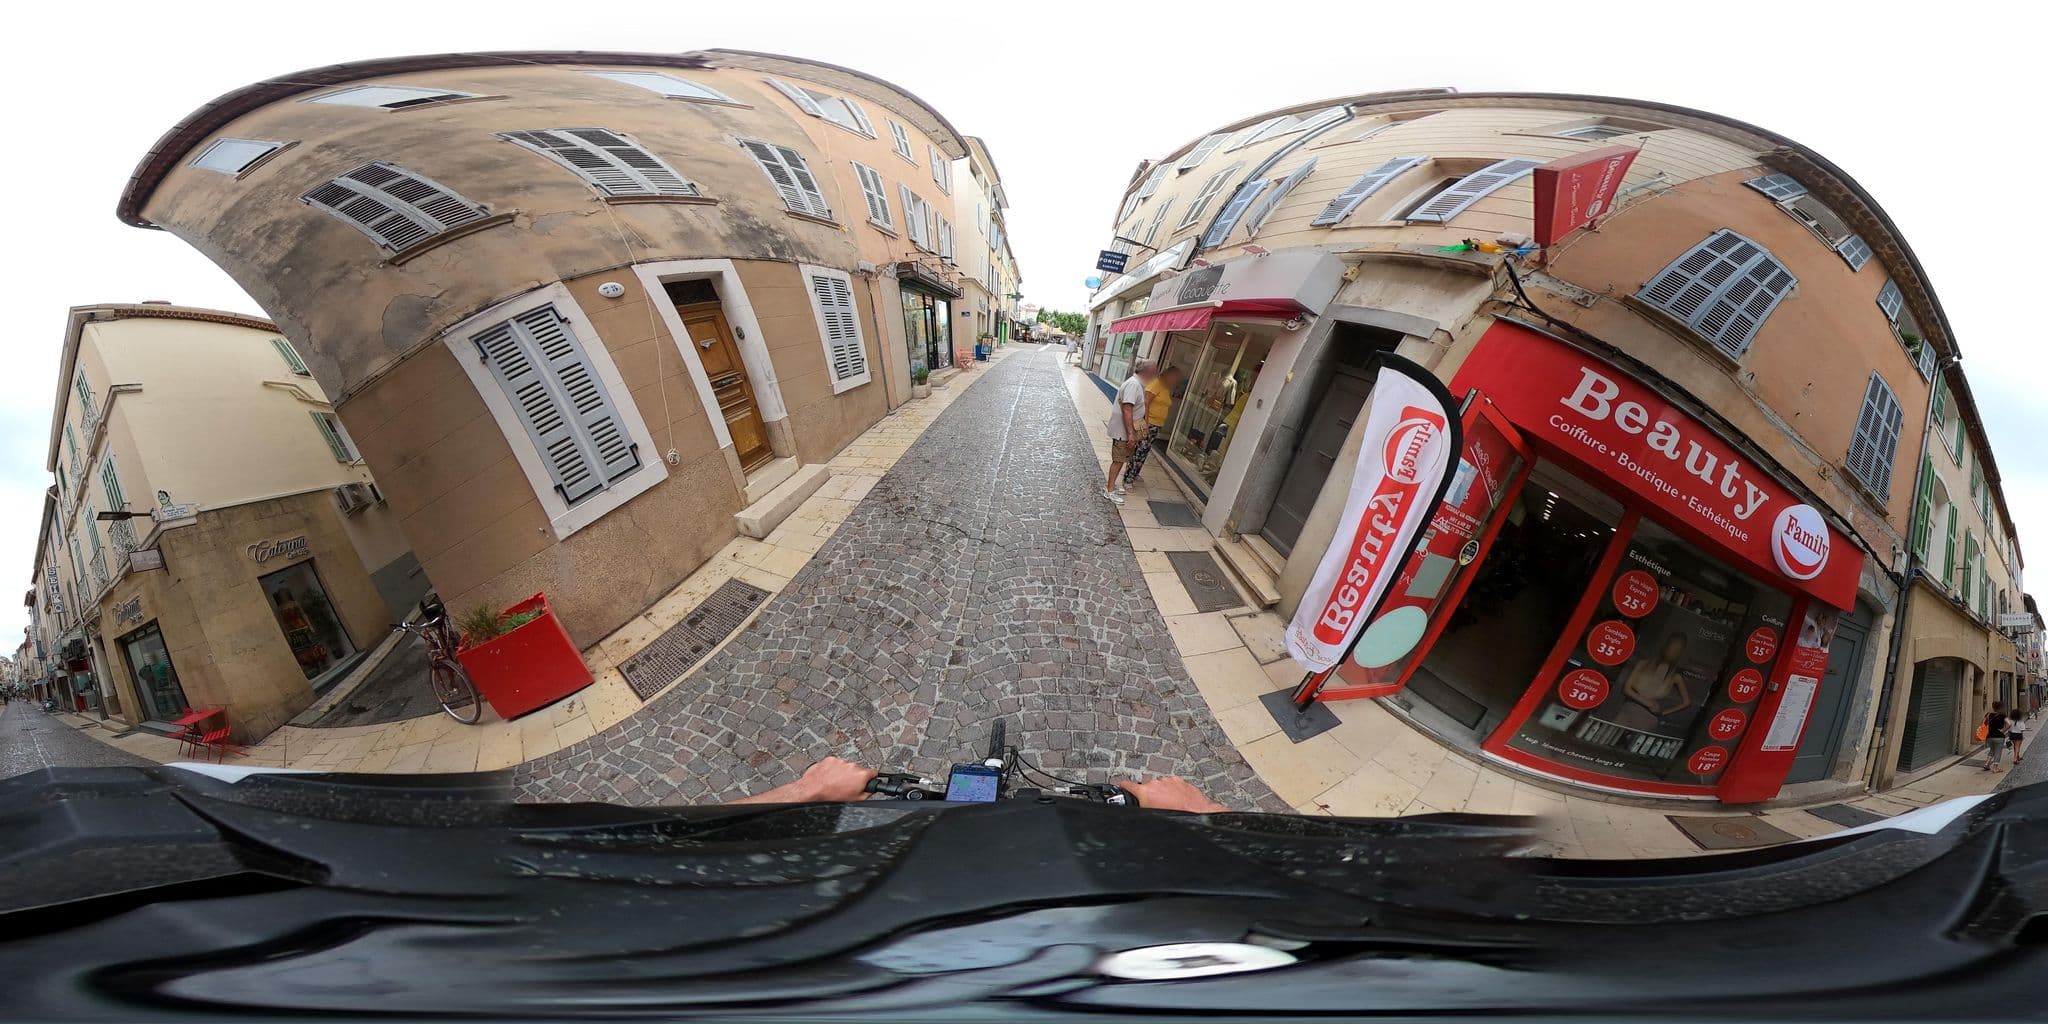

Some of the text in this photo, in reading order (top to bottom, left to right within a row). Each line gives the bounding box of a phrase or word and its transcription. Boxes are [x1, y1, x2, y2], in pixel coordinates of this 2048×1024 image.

[1550, 415, 1749, 542] Coiffure Boutique Esthétique
[1560, 366, 1770, 520] Beauty
[1629, 549, 1672, 577] Esthétique
[1783, 514, 1830, 559] Family
